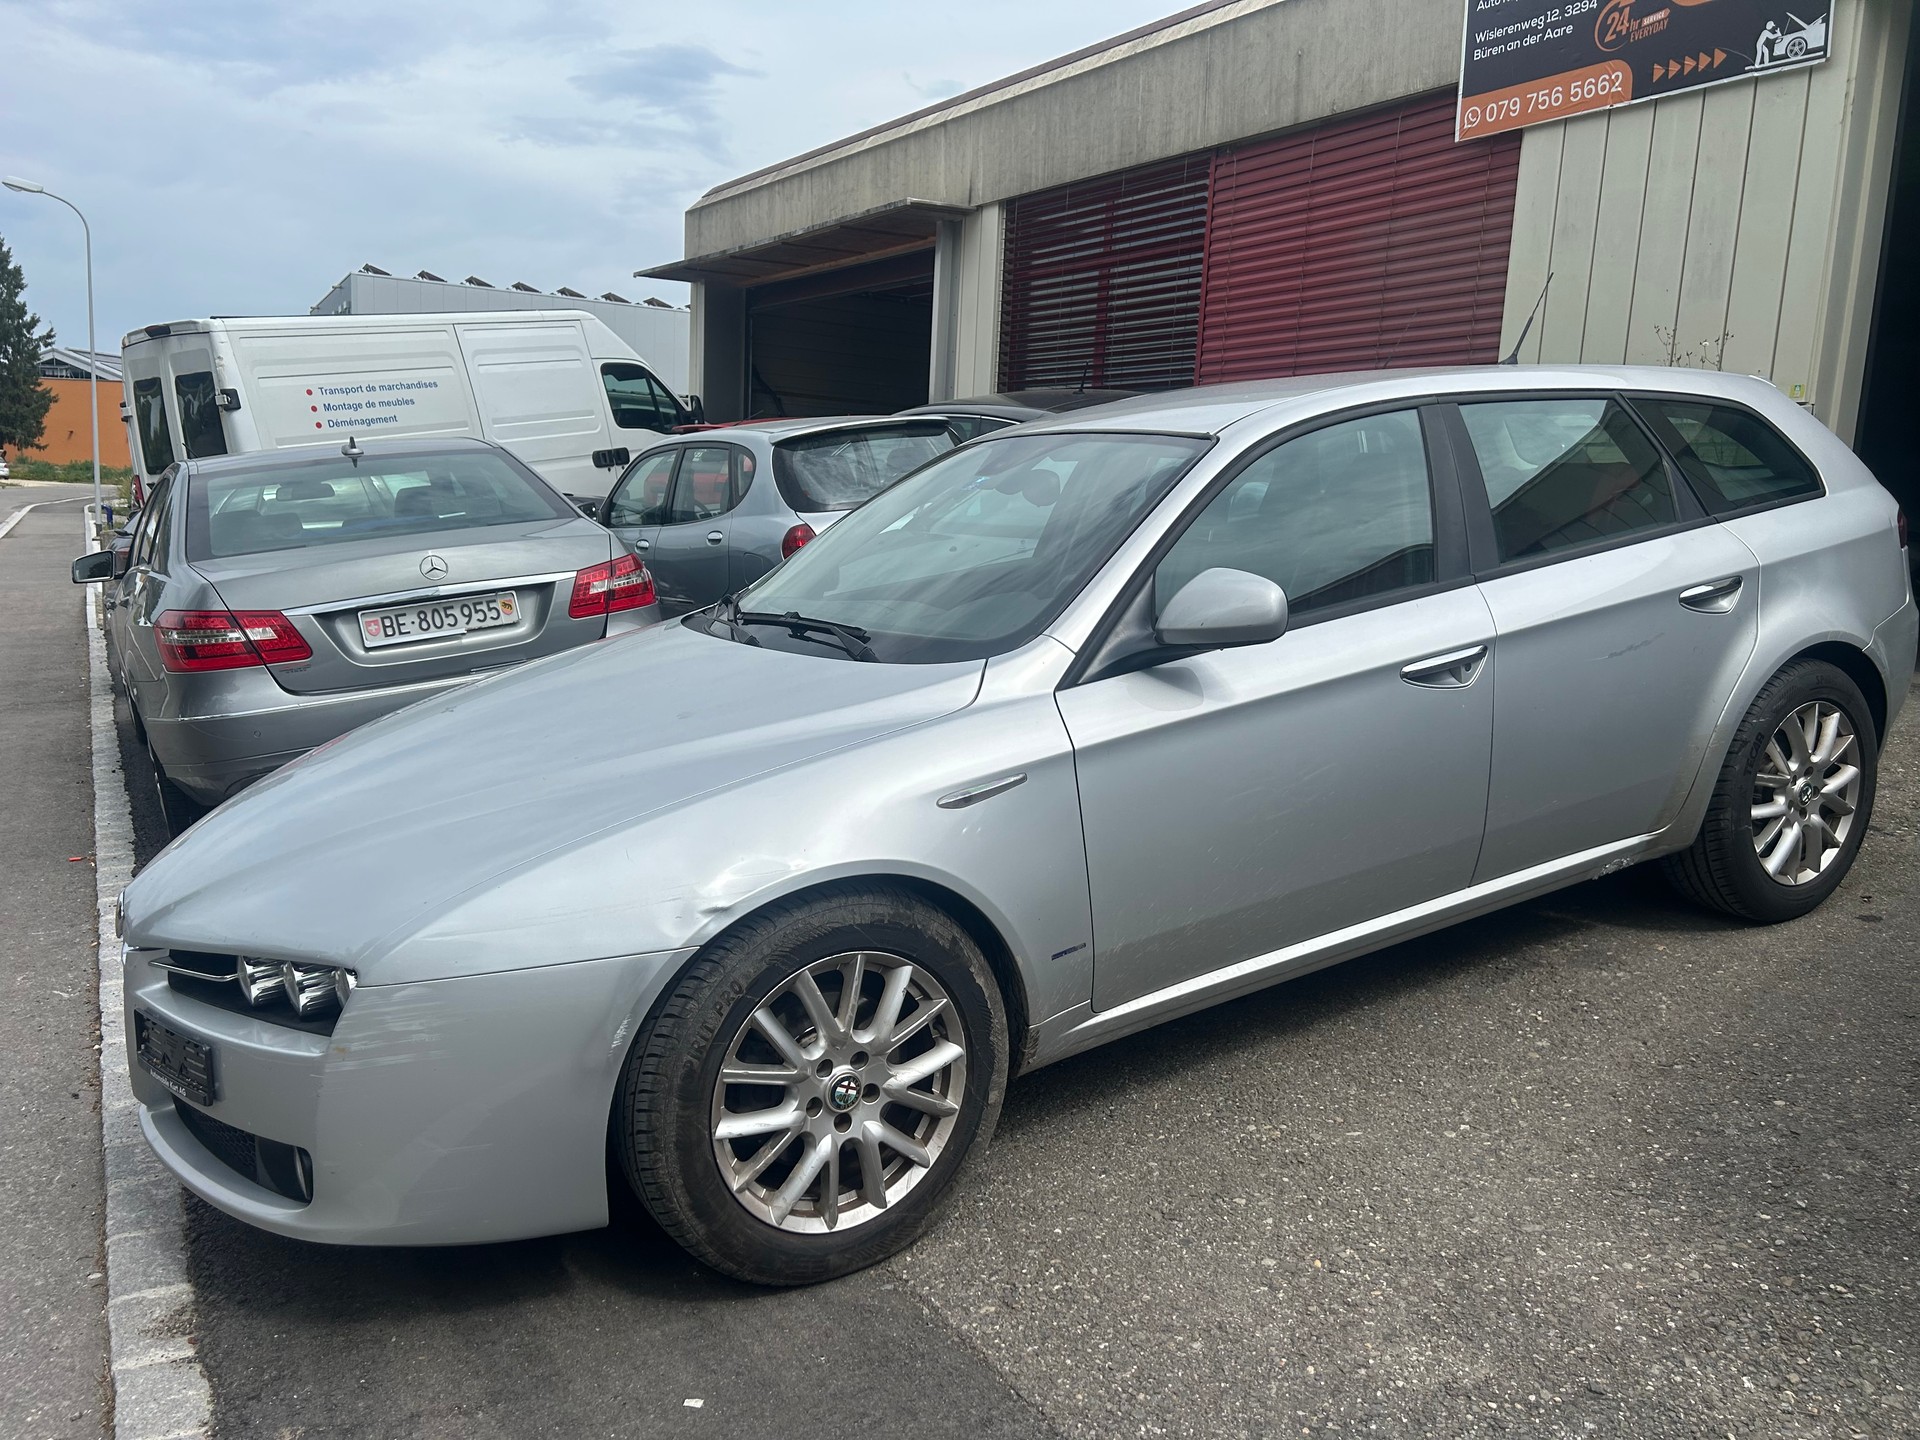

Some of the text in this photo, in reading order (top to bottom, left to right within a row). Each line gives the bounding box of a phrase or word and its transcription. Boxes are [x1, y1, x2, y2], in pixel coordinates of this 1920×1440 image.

[1475, 0, 1598, 44] Wislerenweg 12, 3294
[1604, 6, 1630, 43] 24
[1642, 10, 1666, 27] SERVICE
[1631, 18, 1669, 42] EVERYDAY
[1473, 24, 1574, 61] Büren an der Aare
[1485, 71, 1623, 122] 079 756 5662
[318, 380, 439, 396] Transport de marchandises
[323, 397, 416, 413] Montage de meubles
[327, 414, 398, 428] Déménagement
[713, 980, 745, 1018] PRO
